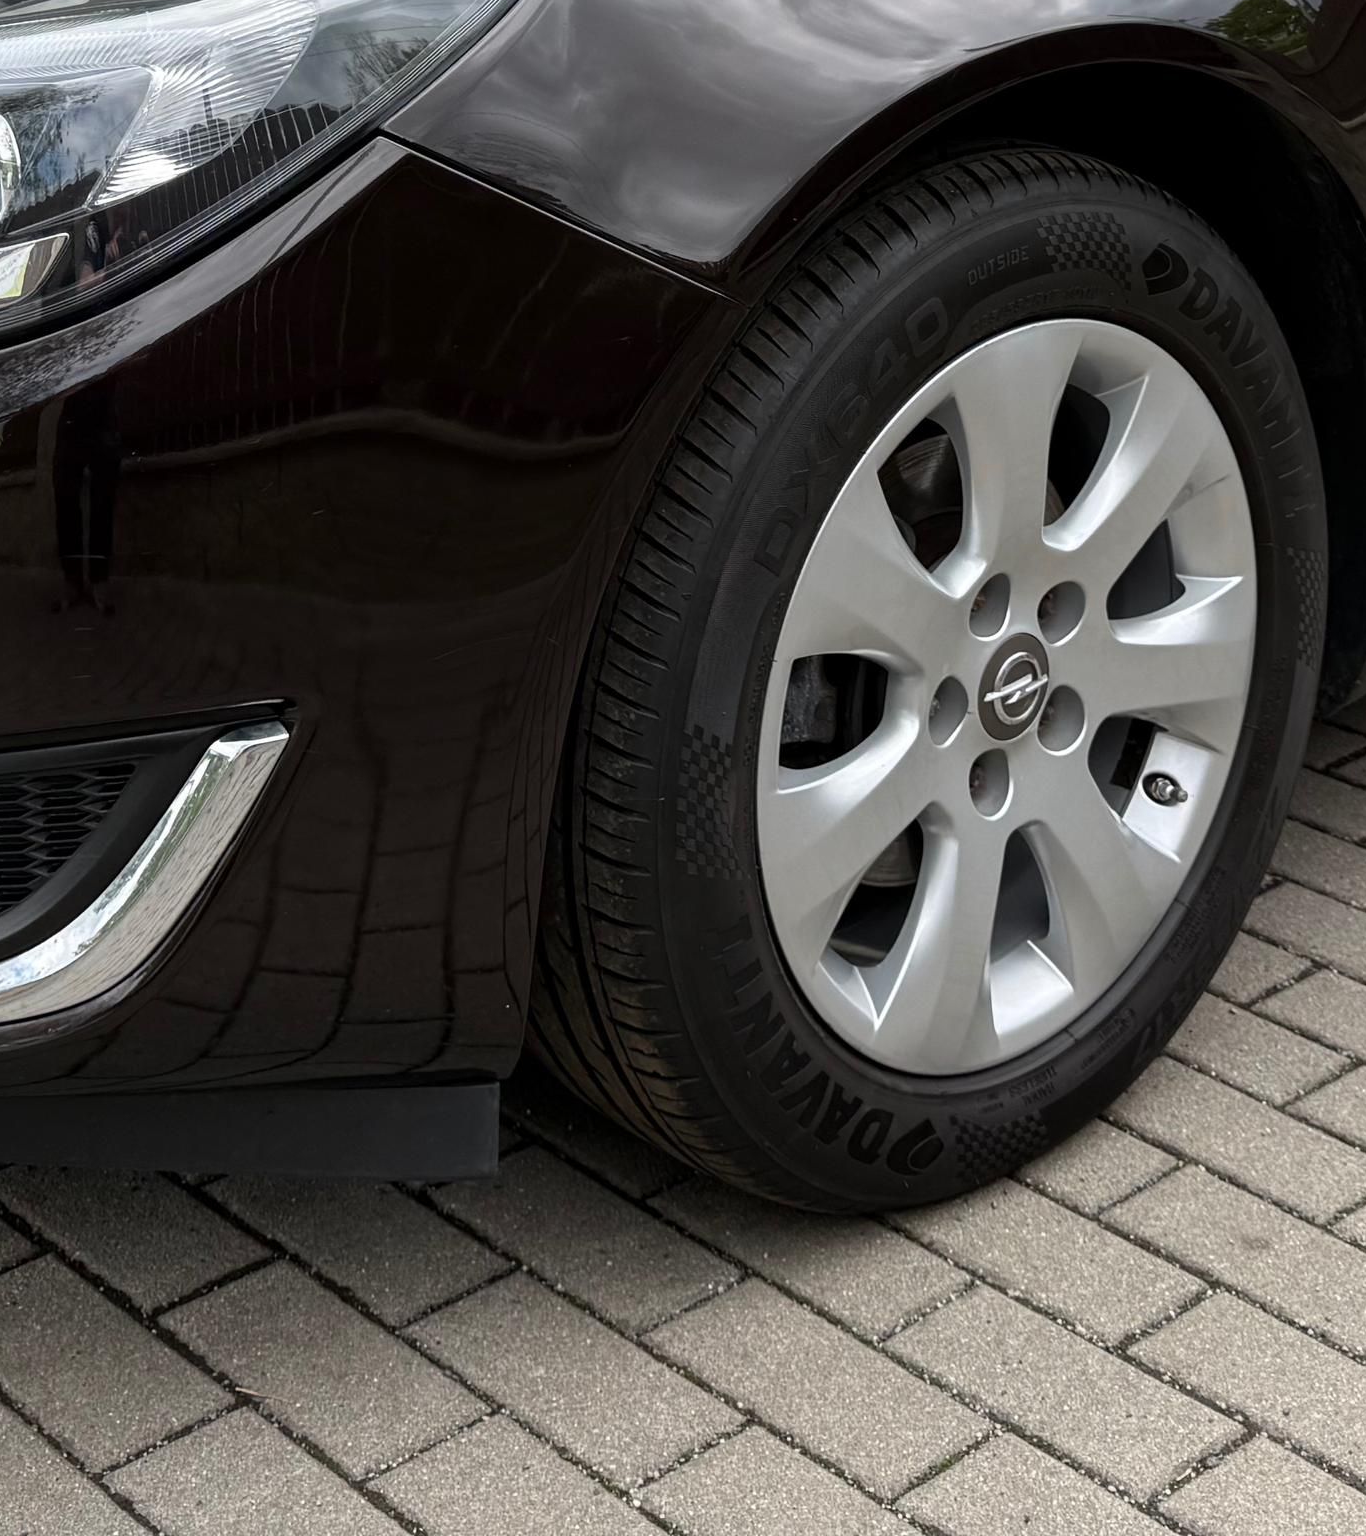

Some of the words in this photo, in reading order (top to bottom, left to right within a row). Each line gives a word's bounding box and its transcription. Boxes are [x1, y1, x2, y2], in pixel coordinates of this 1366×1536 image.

[966, 244, 1030, 288] OUTSIDE
[753, 296, 949, 577] DX640
[697, 912, 893, 1165] DAVANTI
